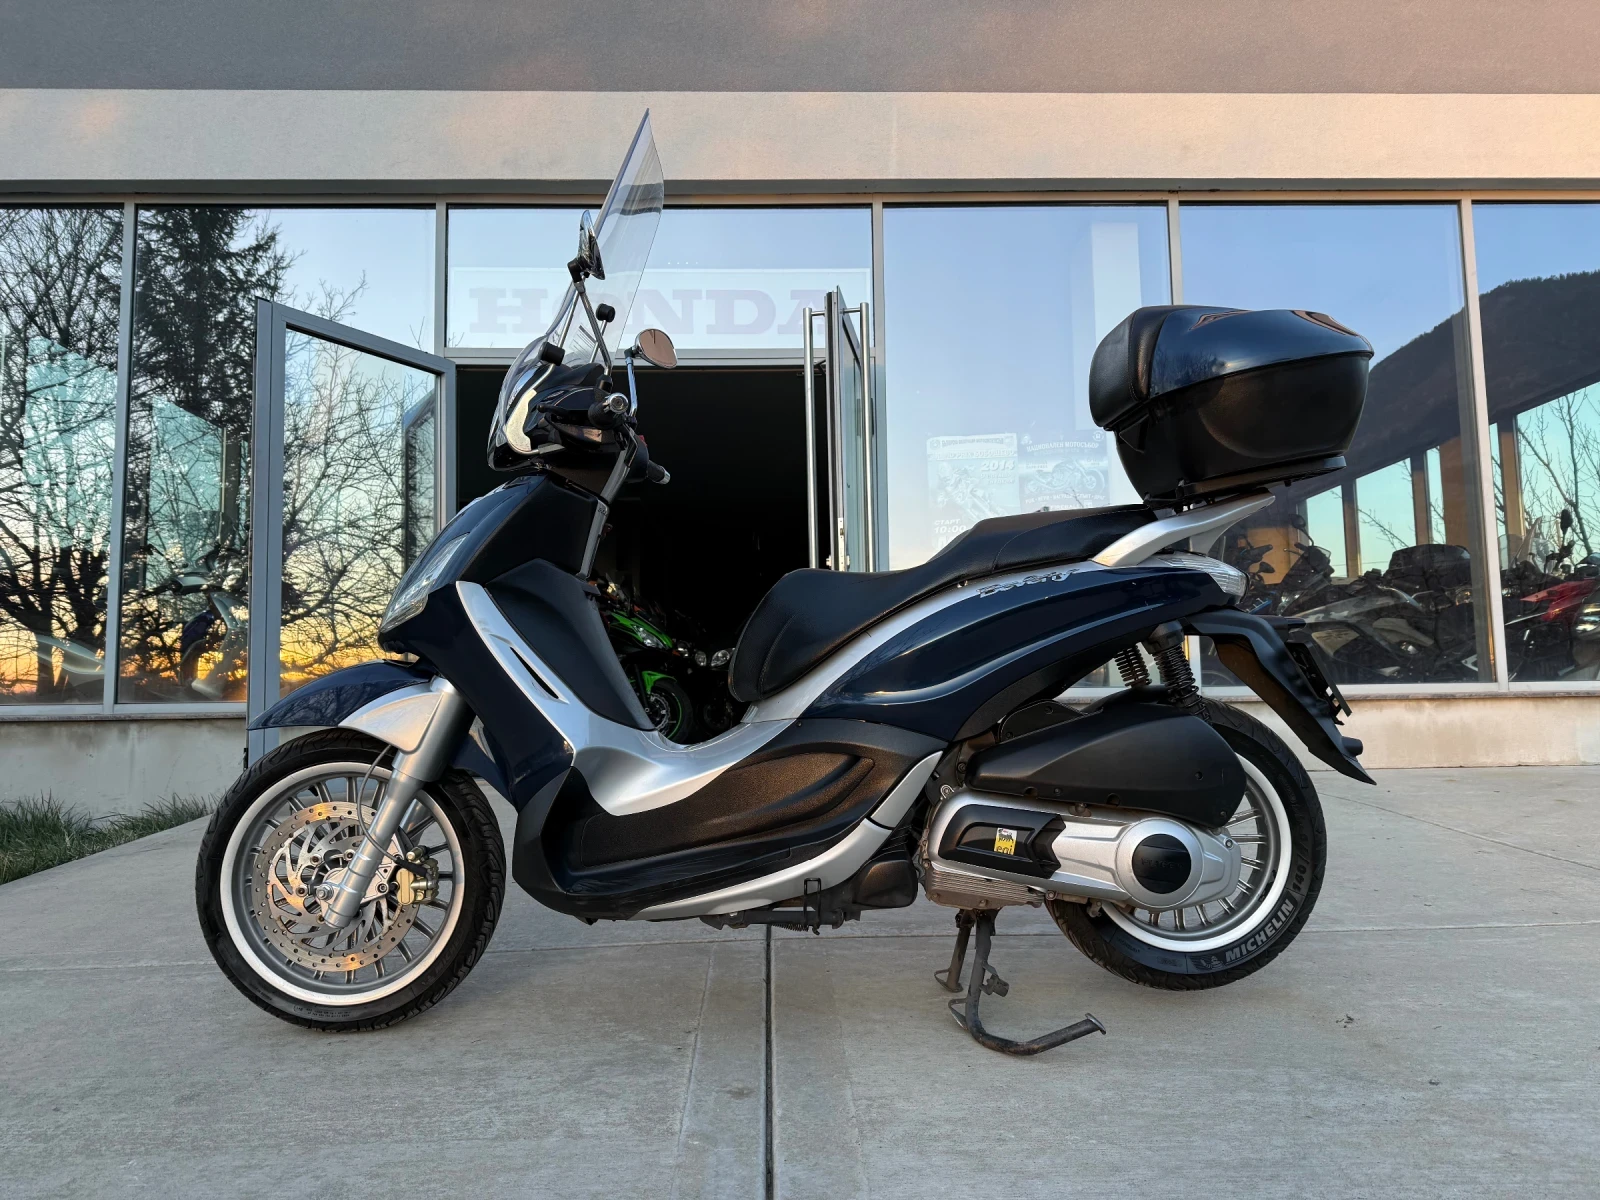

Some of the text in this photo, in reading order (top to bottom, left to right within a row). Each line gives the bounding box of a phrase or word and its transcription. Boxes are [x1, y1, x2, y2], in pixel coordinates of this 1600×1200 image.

[469, 288, 827, 335] HONDA
[981, 459, 1016, 471] 2014
[934, 518, 961, 526] СТАРТ
[933, 525, 967, 534] 10:00
[1225, 898, 1296, 962] MICHELIN
